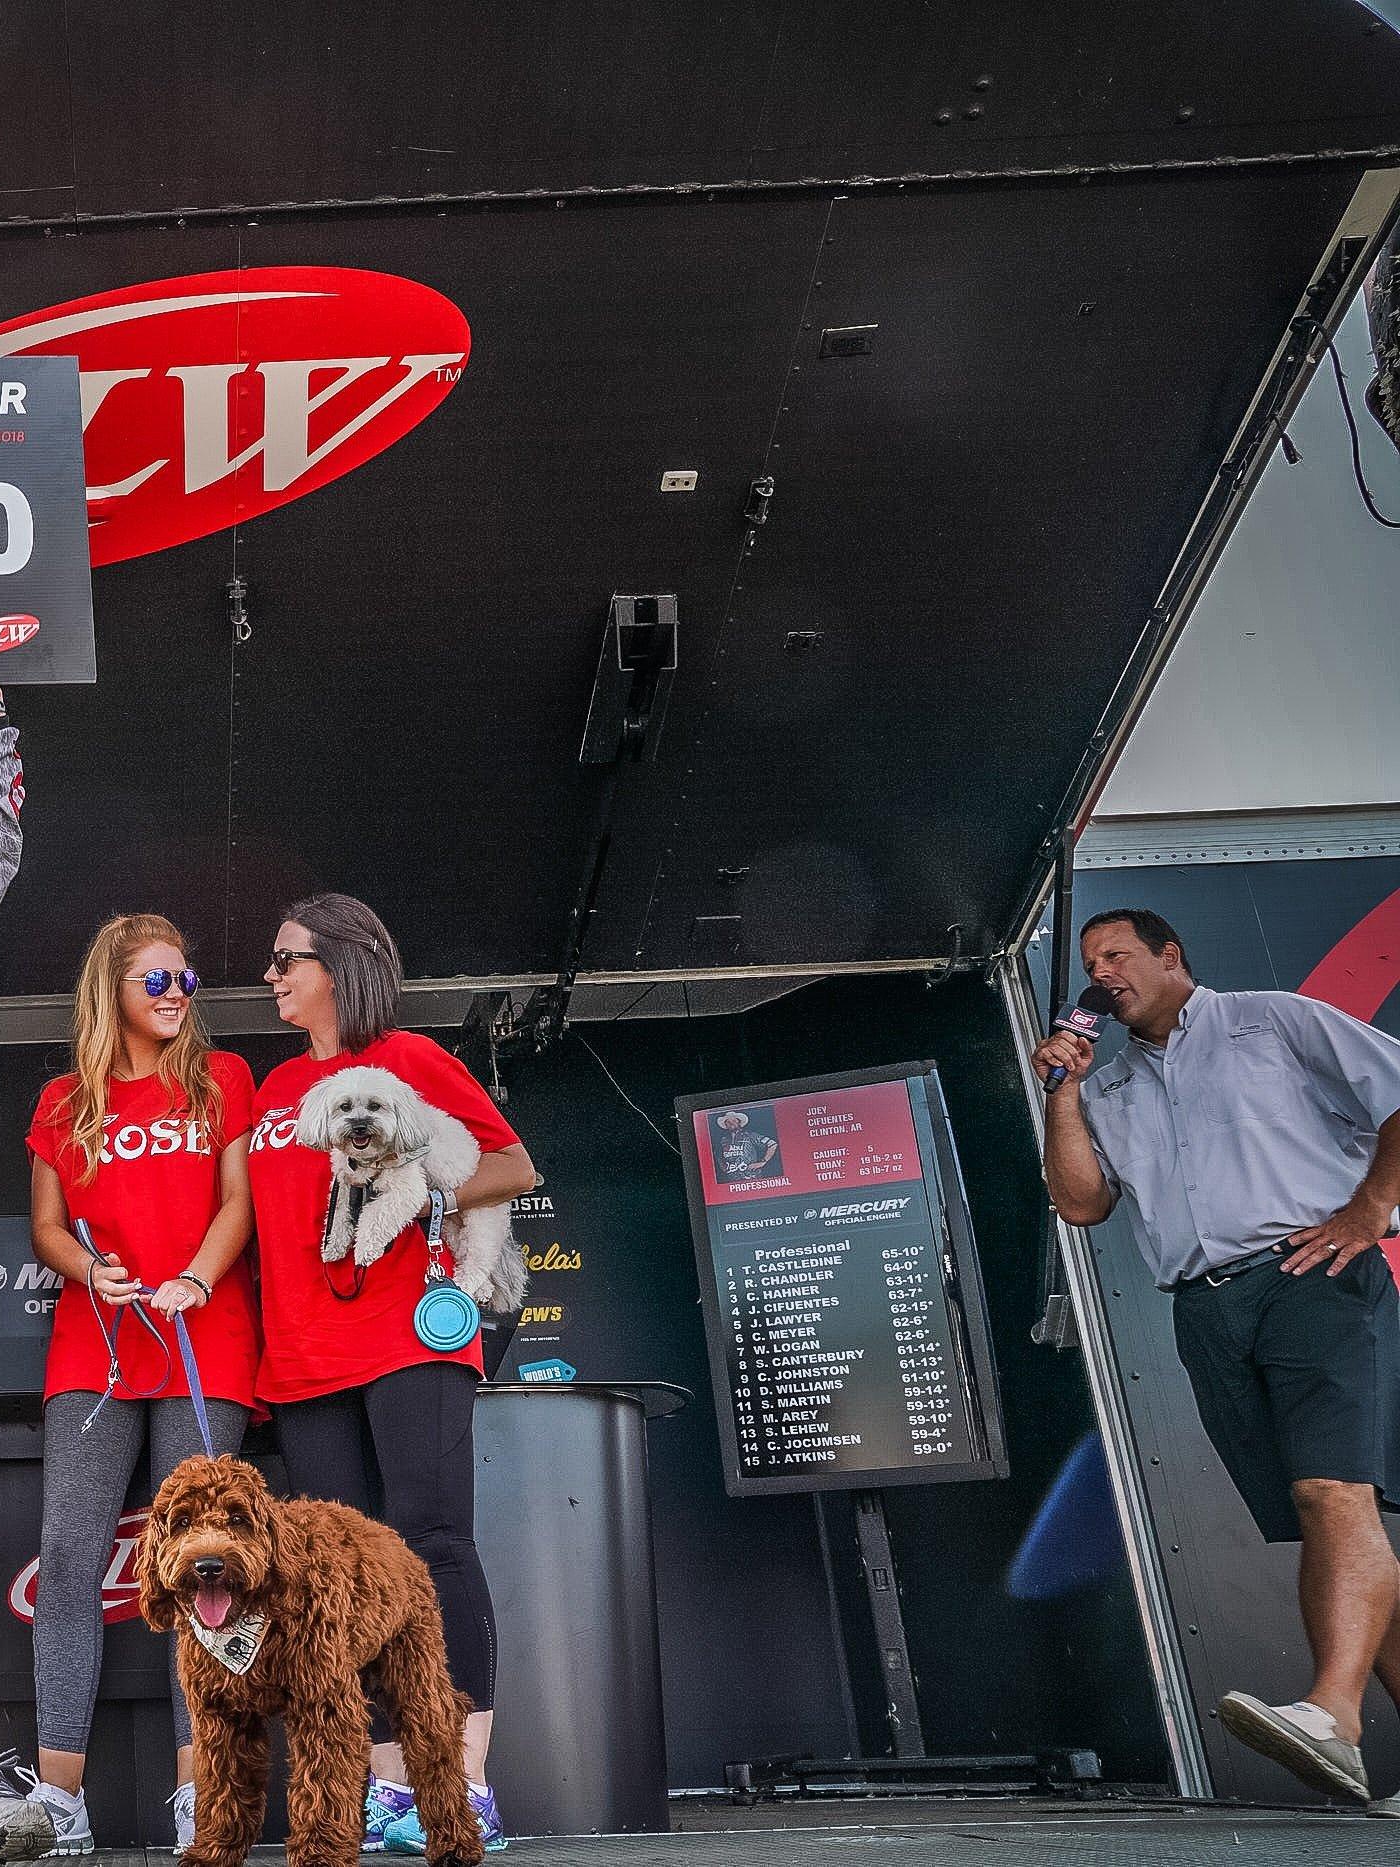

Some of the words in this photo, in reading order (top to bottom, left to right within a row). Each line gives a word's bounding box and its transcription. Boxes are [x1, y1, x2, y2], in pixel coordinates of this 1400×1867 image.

[79, 353, 465, 500] LW
[806, 1106, 827, 1116] JOEY
[808, 1113, 854, 1127] CIFUENTES
[850, 1123, 863, 1132] AR
[249, 1119, 303, 1154] RO
[813, 1148, 850, 1160] CAUGHT:
[815, 1160, 845, 1170] TODAY:
[860, 1156, 871, 1165] 19
[892, 1153, 903, 1161] oz
[816, 1170, 846, 1181] TOTAL:
[859, 1167, 870, 1175] 63
[729, 1177, 792, 1192] PROFESSIONAL
[511, 1196, 554, 1211] OSTA
[818, 1197, 912, 1219] MERCURY
[725, 1217, 783, 1232] PRESENTED
[785, 1216, 799, 1226] BY
[824, 1214, 866, 1227] OFFICIAL
[866, 1211, 902, 1222] ENGINE
[754, 1240, 851, 1261] Professional
[726, 1267, 733, 1277] 1
[742, 1265, 756, 1275] T.
[758, 1255, 843, 1273] CASTLEDINE
[727, 1281, 737, 1290] 2
[744, 1279, 758, 1288] R.
[760, 1270, 834, 1286] CHANDLER
[729, 1294, 738, 1303] 3
[746, 1292, 760, 1301] C.
[762, 1285, 820, 1300] HAHNER
[731, 1307, 740, 1316] 4
[748, 1305, 761, 1315] J.
[763, 1296, 840, 1313] CIFUENTES
[733, 1321, 742, 1330] 5
[750, 1319, 762, 1328] J.
[765, 1312, 822, 1327] LAWYER
[735, 1334, 744, 1343] 6
[752, 1332, 766, 1341] C.
[768, 1326, 816, 1340] MEYER
[736, 1347, 745, 1357] 7
[753, 1345, 770, 1355] W.
[773, 1340, 821, 1353] LOGAN
[739, 1361, 747, 1370] 8
[755, 1359, 769, 1368] S.
[772, 1349, 865, 1367] CANTERBURY
[523, 1366, 562, 1382] WORLD'S
[740, 1374, 749, 1383] 9
[757, 1373, 771, 1382] C.
[774, 1364, 850, 1381] JOHNSTON
[735, 1388, 751, 1398] 10
[759, 1386, 773, 1395] D.
[776, 1379, 844, 1394] WILLIAMS
[736, 1401, 752, 1411] 11
[761, 1400, 774, 1409] S.
[777, 1394, 831, 1408] MARTIN
[738, 1415, 755, 1425] 12
[762, 1413, 778, 1423] M.
[781, 1410, 818, 1422] AREY
[740, 1429, 757, 1438] 13
[765, 1427, 778, 1437] S.
[781, 1422, 829, 1436] LEHEW
[742, 1443, 758, 1453] 14
[767, 1441, 781, 1451] C.
[784, 1434, 862, 1449] JOCUMSEN
[744, 1456, 760, 1466] 15
[768, 1455, 781, 1465] J.
[784, 1450, 836, 1464] ATKINS
